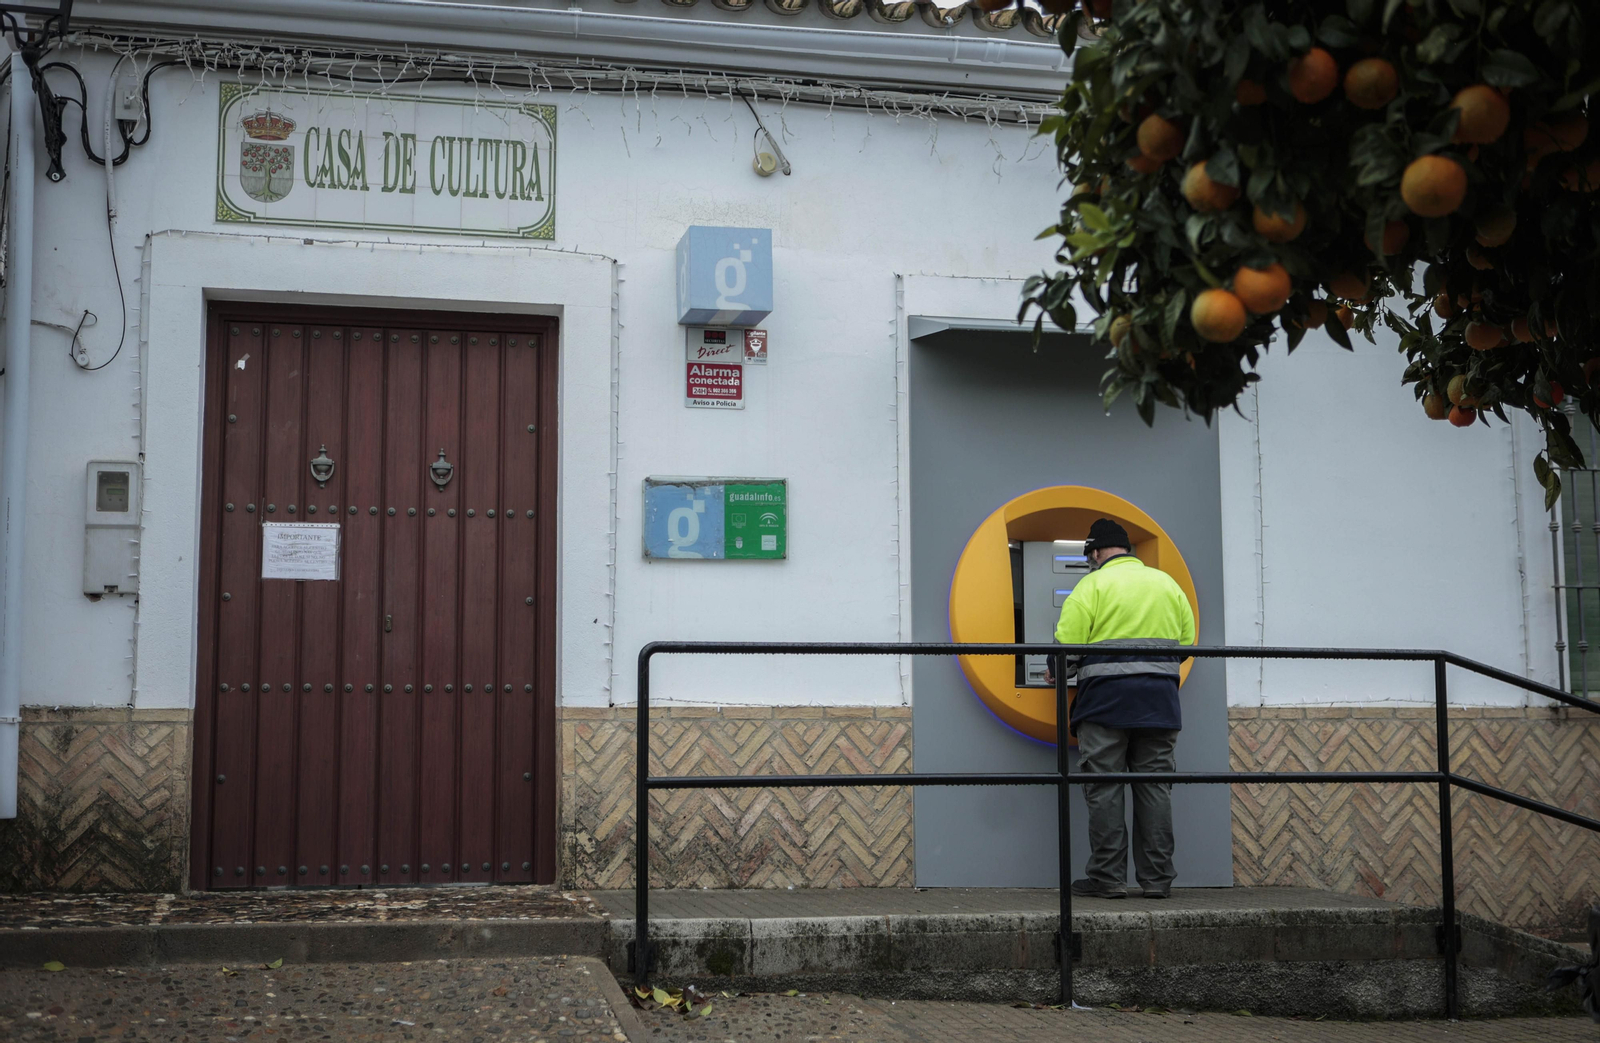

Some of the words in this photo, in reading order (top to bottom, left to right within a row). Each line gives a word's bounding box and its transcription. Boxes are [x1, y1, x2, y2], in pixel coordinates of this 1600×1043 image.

[303, 127, 370, 192] CASA
[381, 131, 417, 195] DE
[429, 135, 545, 202] CULTURA
[697, 344, 736, 359] Direct
[689, 364, 740, 378] Alarma
[689, 377, 740, 386] conectada
[729, 492, 781, 503] guadalinfo.es
